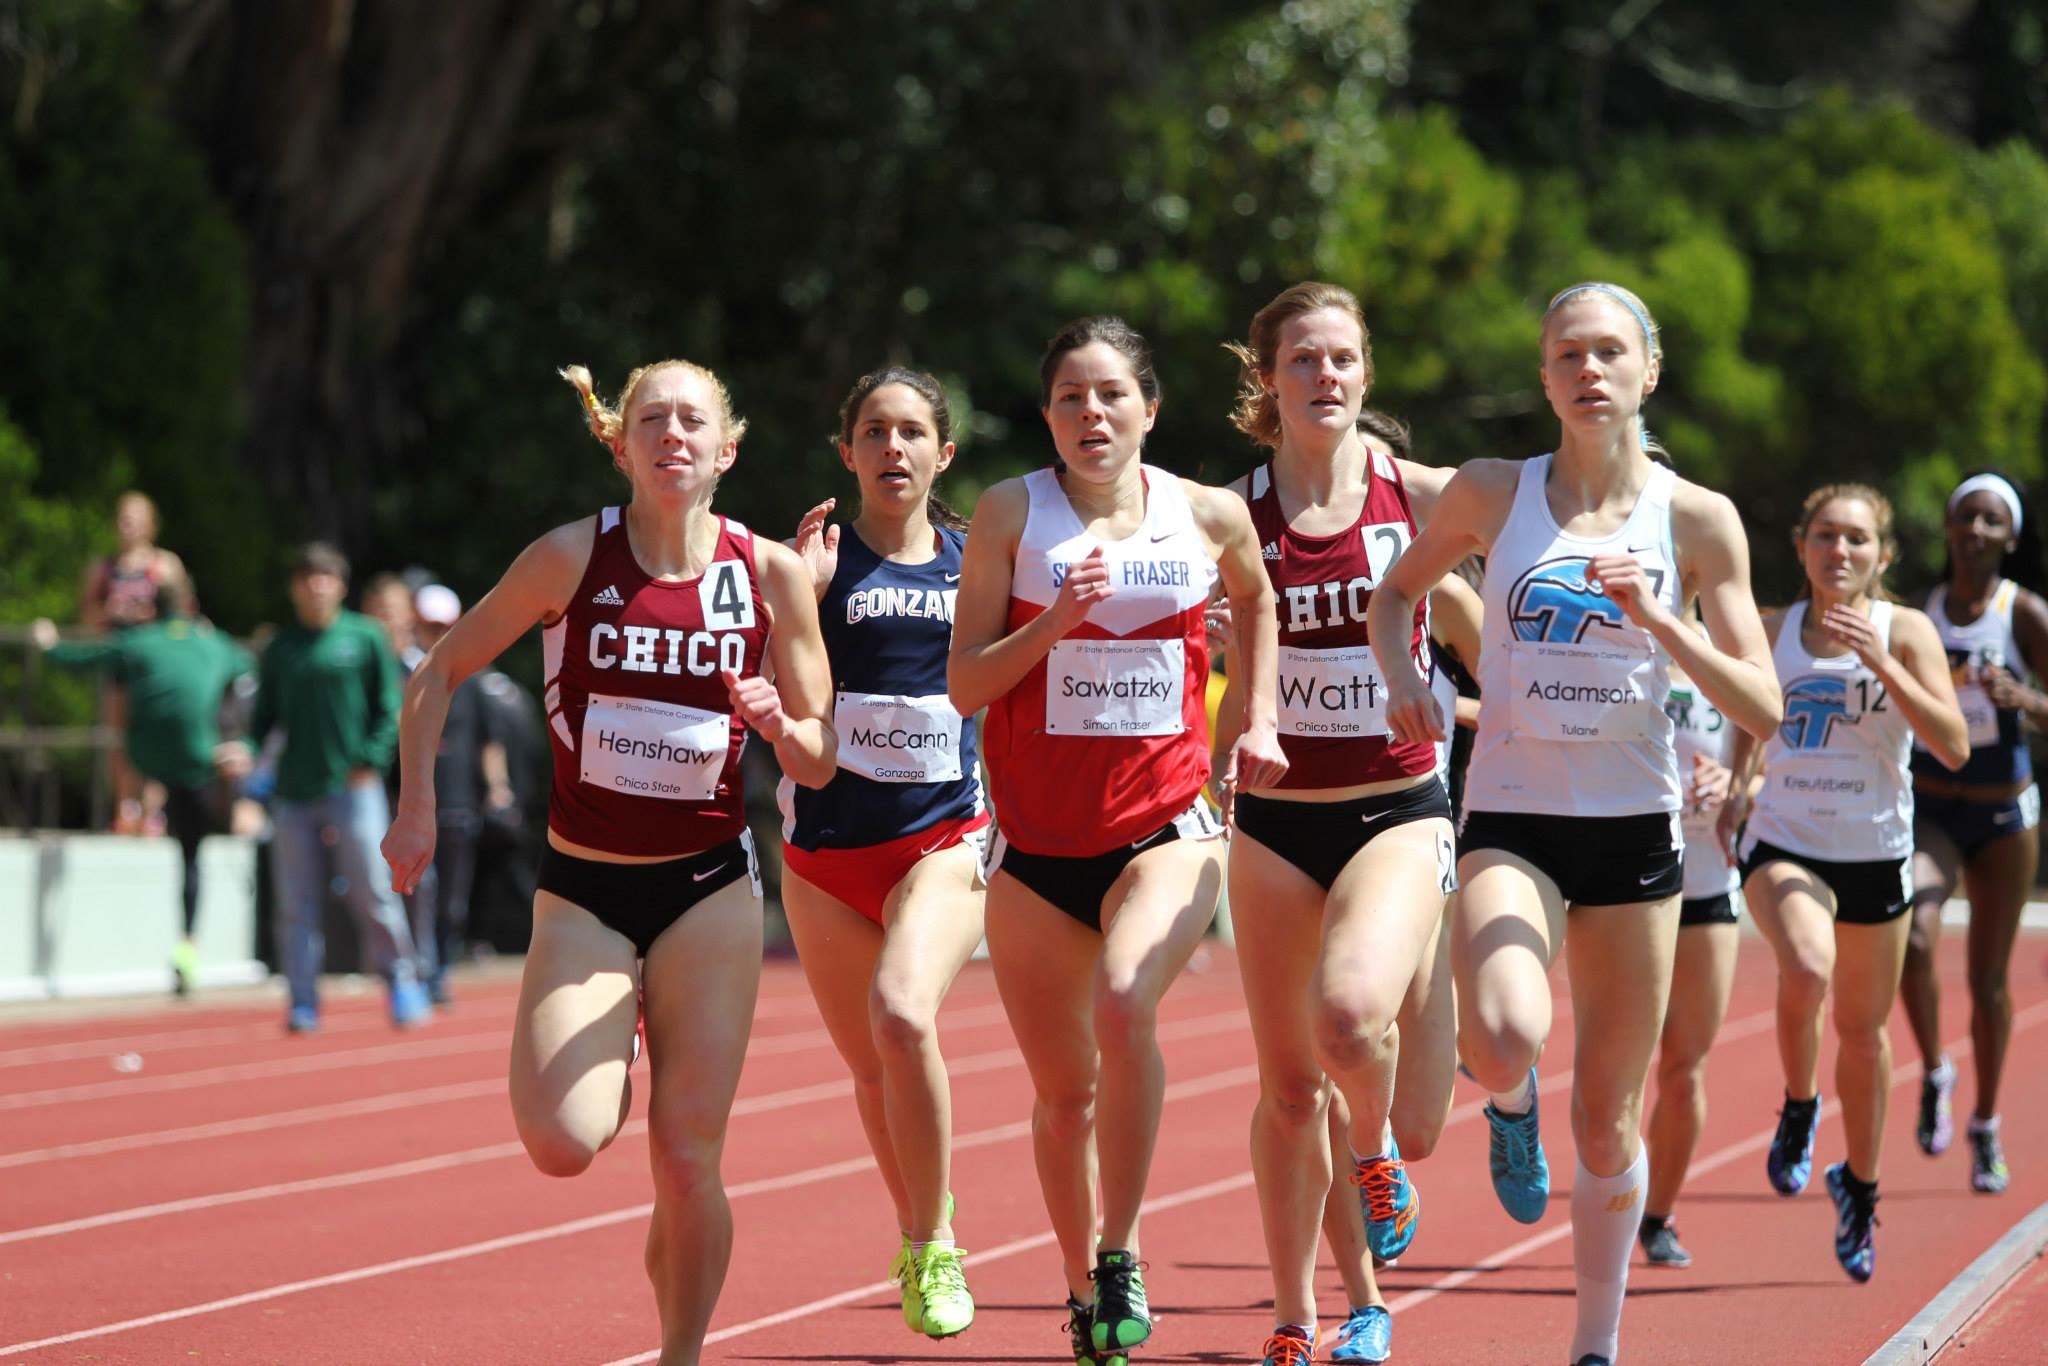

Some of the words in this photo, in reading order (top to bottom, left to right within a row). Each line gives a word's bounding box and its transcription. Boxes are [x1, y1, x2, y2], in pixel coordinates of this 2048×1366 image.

[1123, 560, 1190, 587] FRASER
[592, 596, 625, 606] adidas
[711, 565, 746, 624] 4
[588, 622, 746, 677] CHICO
[1062, 675, 1173, 702] Sawatzky
[1279, 674, 1378, 711] Watt
[1526, 680, 1637, 705] Adamson
[1855, 678, 1888, 713] 12
[644, 706, 674, 717] Distance
[675, 711, 704, 722] Carnival
[1083, 719, 1117, 730] Simon
[1120, 719, 1151, 730] Fraser
[850, 727, 948, 749] McCann
[1295, 721, 1328, 732] Chico
[1330, 722, 1360, 733] State
[1561, 724, 1600, 737] Tulane
[598, 729, 713, 765] Henshaw
[615, 775, 649, 791] Chico
[651, 780, 681, 794] State
[875, 767, 925, 780] Gonzaga
